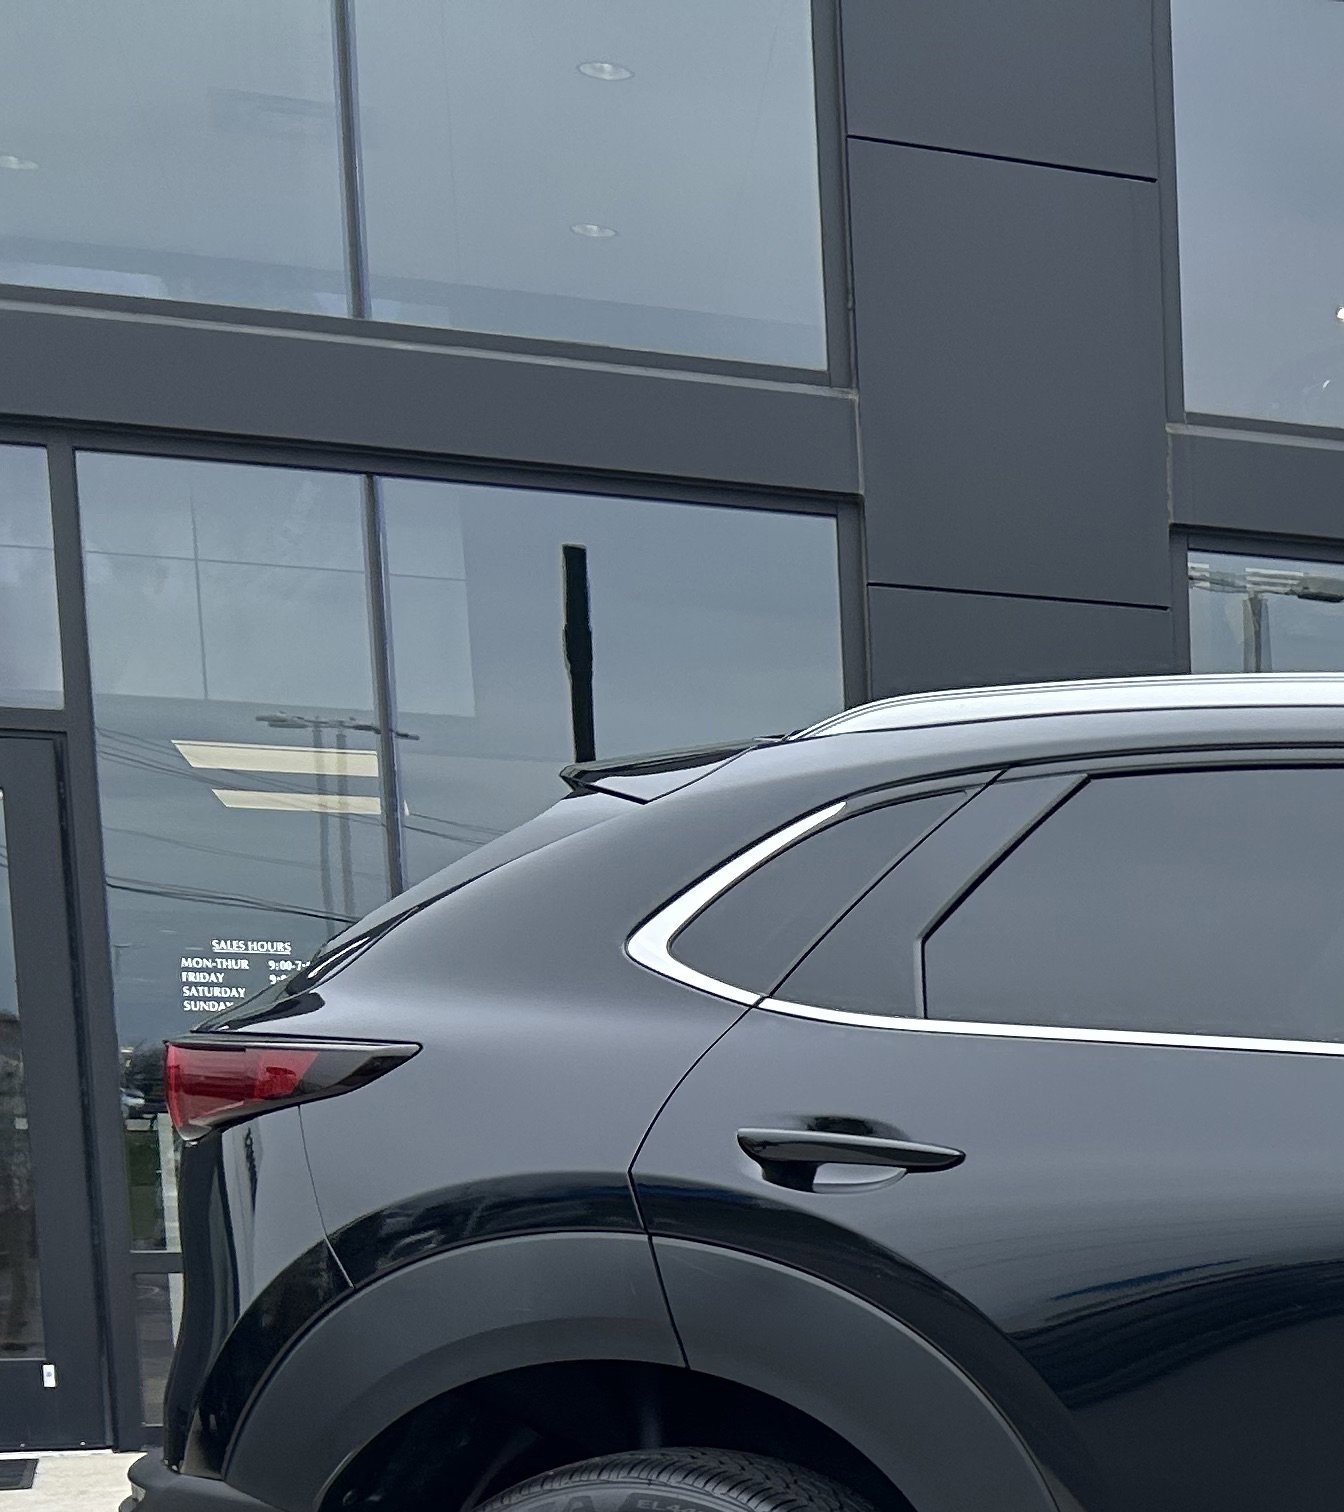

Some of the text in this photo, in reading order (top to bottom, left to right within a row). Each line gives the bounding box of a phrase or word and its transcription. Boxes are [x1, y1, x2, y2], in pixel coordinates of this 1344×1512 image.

[211, 940, 292, 953] SALES HOURS
[181, 958, 250, 970] MON-THUR
[181, 972, 225, 983] FRIDAY
[182, 986, 247, 998] SATURDAY
